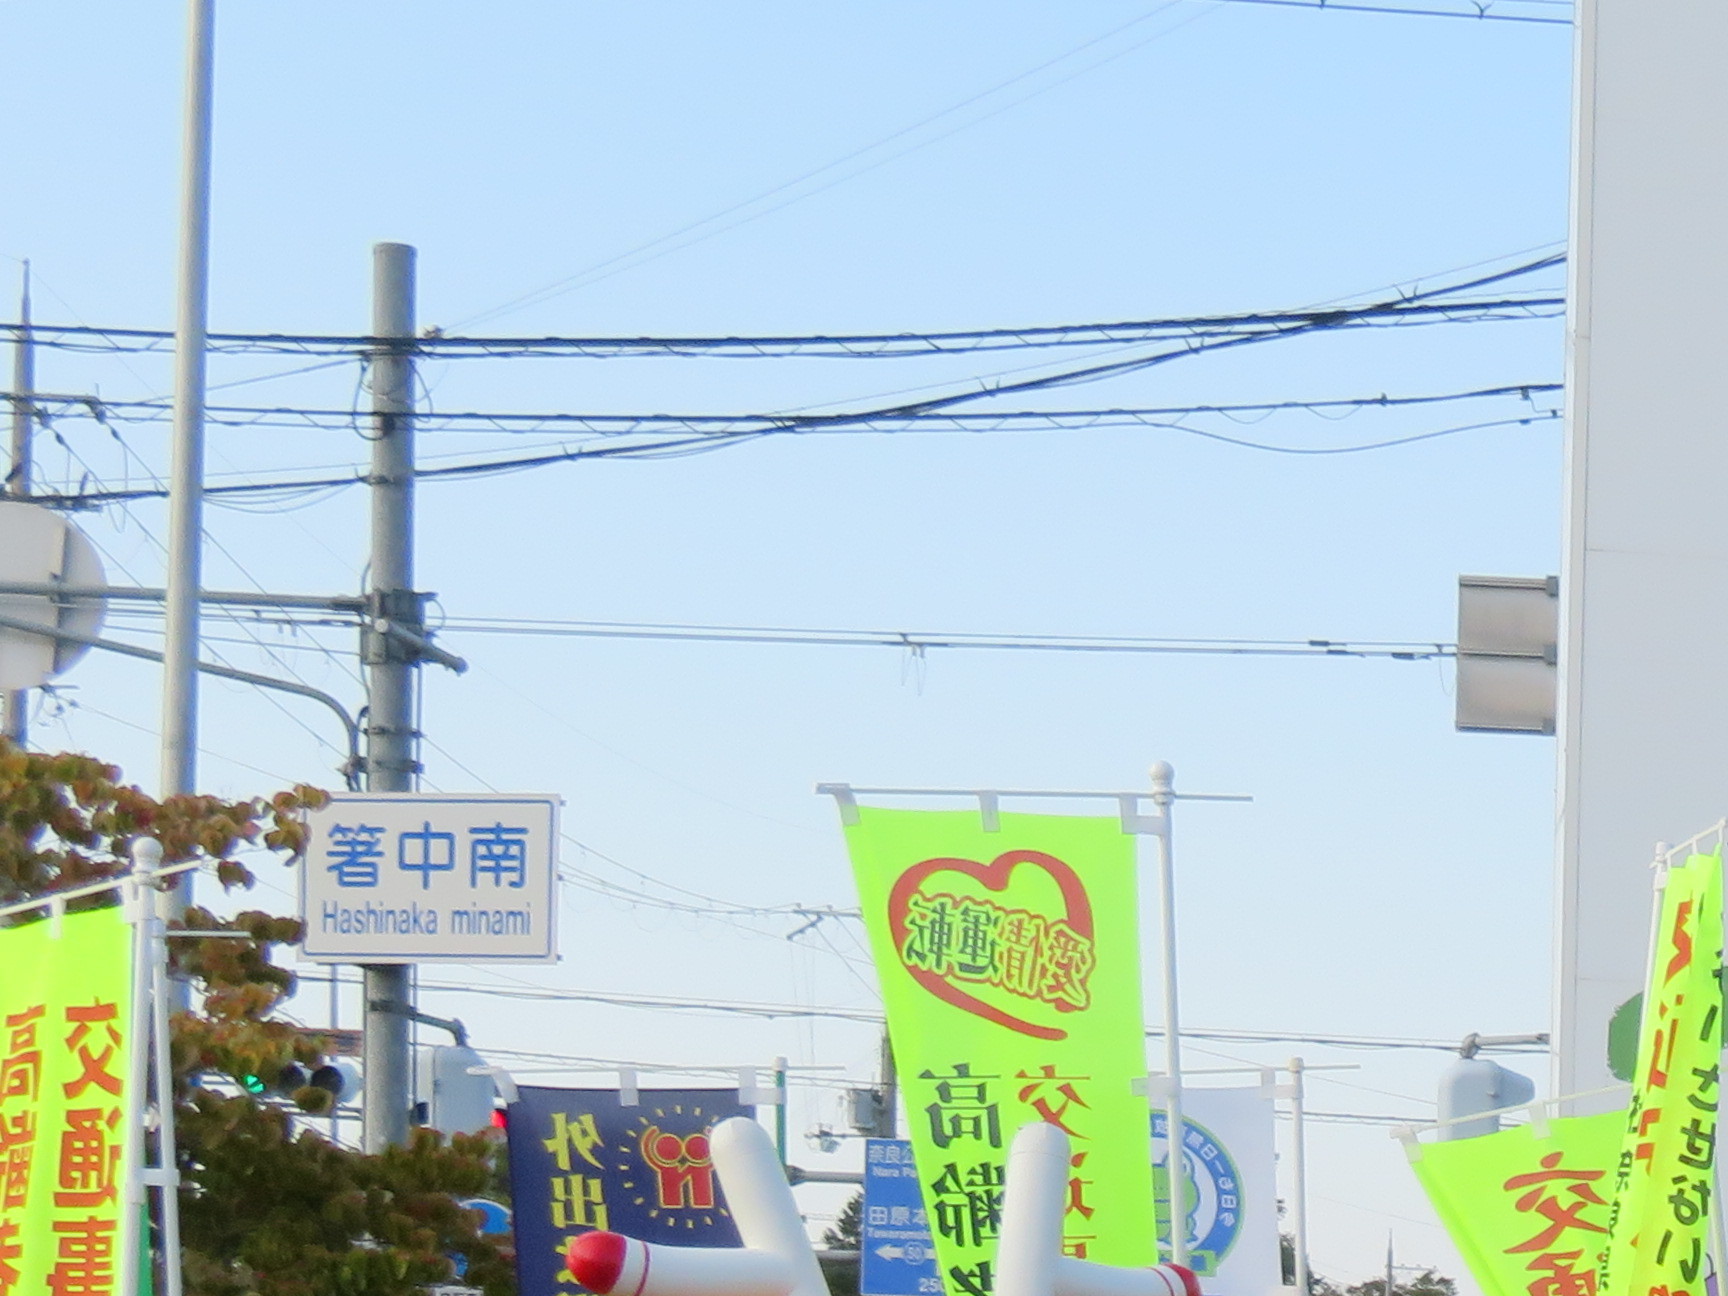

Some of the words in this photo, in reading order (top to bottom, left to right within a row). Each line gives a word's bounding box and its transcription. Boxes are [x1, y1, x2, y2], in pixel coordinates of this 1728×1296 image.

[326, 821, 530, 890] 箸中南
[322, 900, 438, 936] Hashinaka
[451, 901, 531, 936] minami
